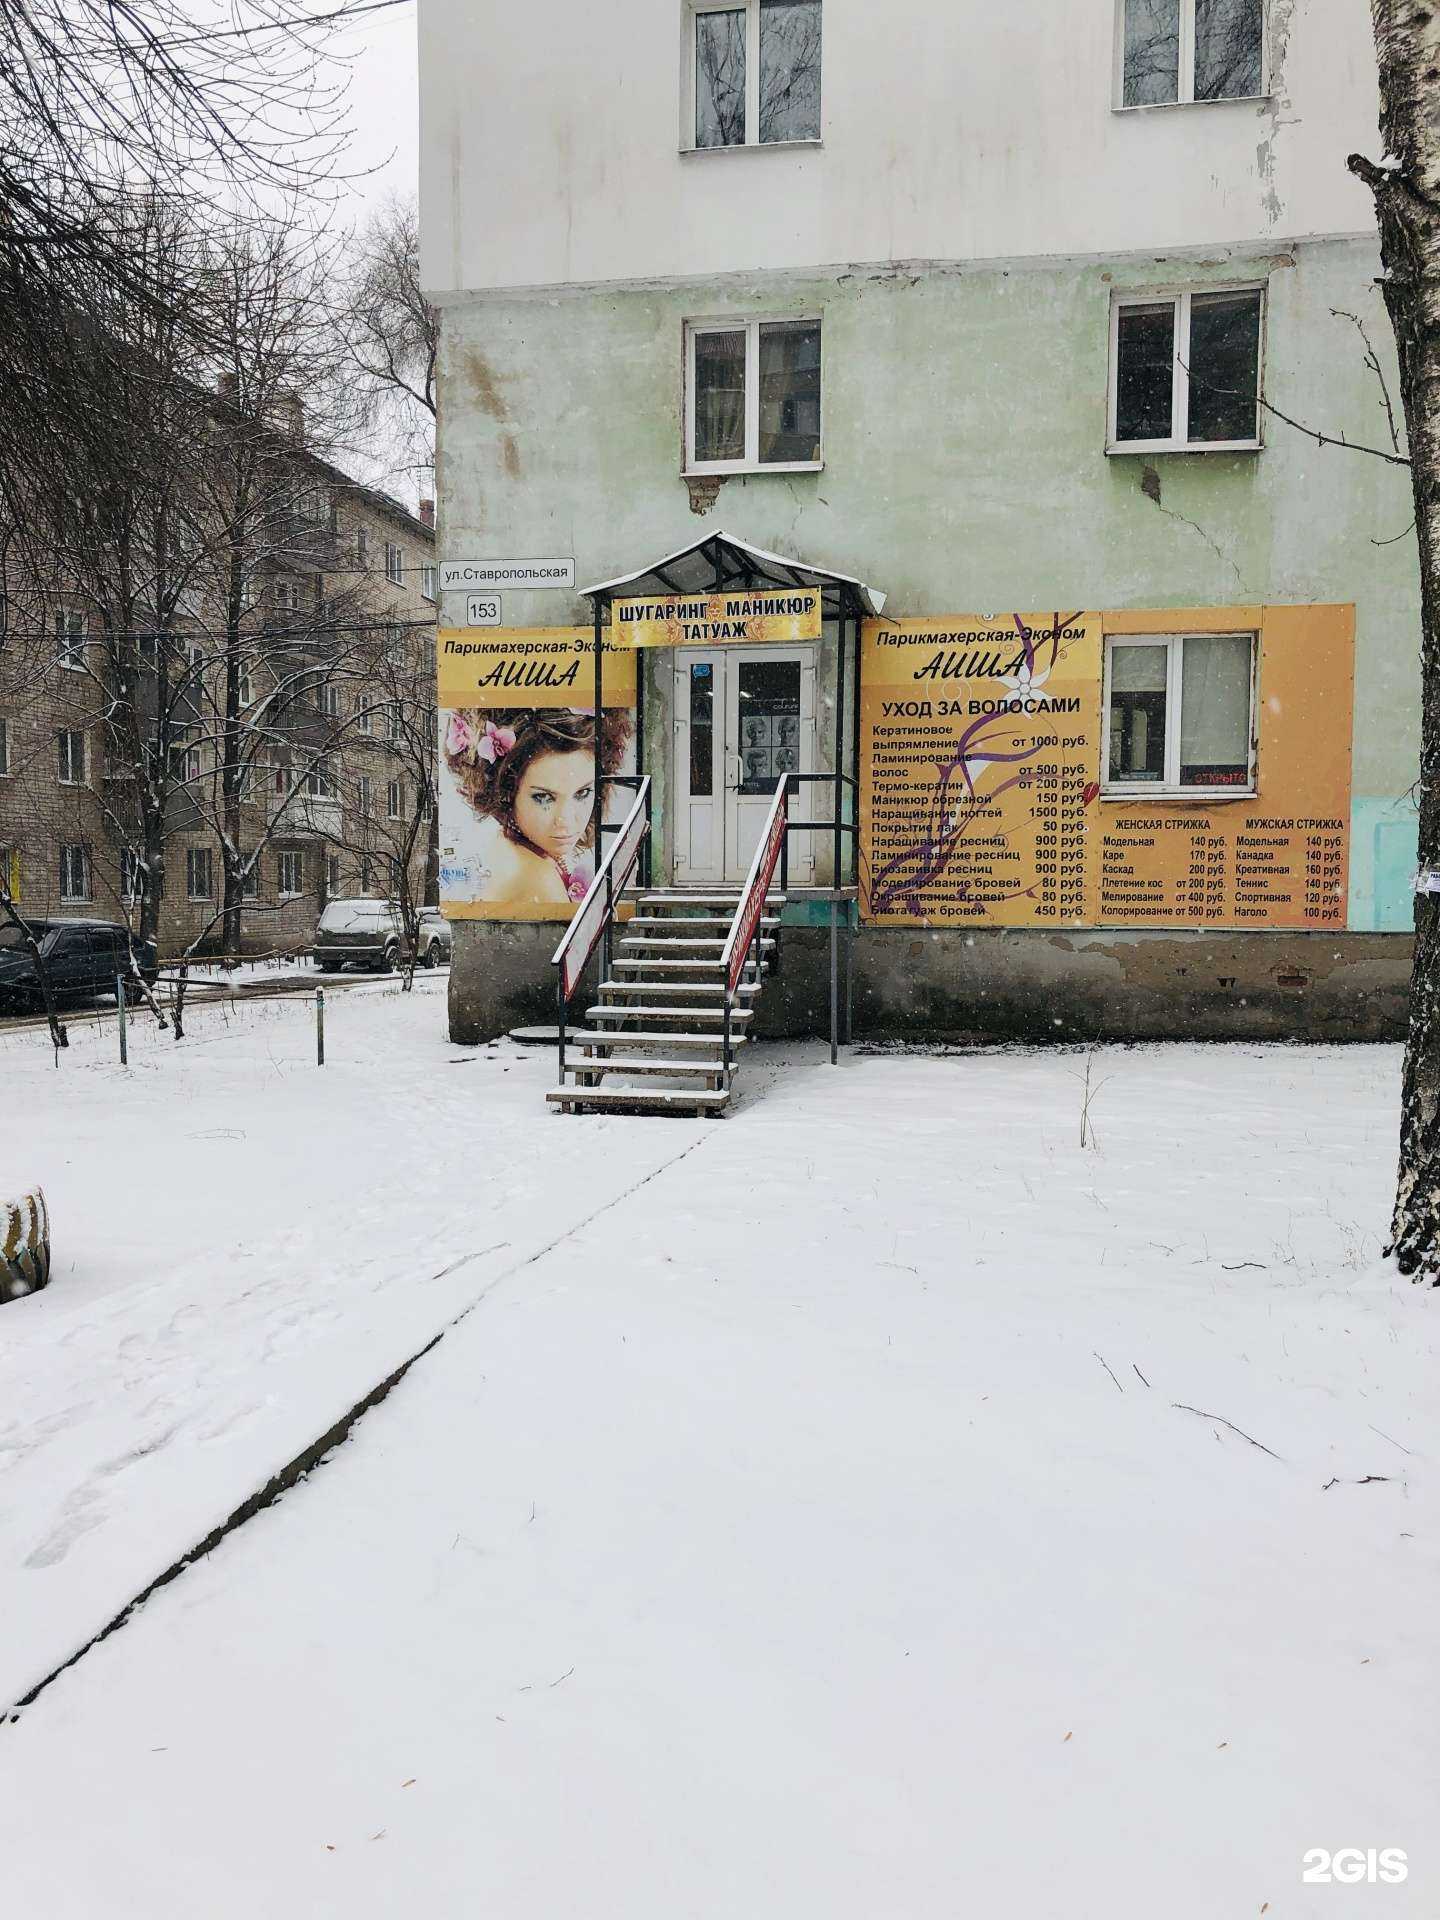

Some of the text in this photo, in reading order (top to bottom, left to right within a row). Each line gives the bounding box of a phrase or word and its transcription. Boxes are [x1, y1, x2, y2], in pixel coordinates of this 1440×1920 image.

[445, 567, 568, 582] ул.Ставропольская
[470, 602, 497, 618] 153
[619, 597, 815, 622] ШУГАРИНГ МАНИКЮР
[682, 621, 748, 640] ТАТУАЖ
[877, 627, 1085, 647] Парикмахерская-Эконом
[914, 649, 1027, 679] АИША
[479, 660, 580, 687] АИША
[882, 698, 1080, 718] УХОД ЗА ВОЛОСАМИ
[873, 726, 952, 736] Кератиновое
[873, 736, 1089, 749] выпрямление от 1000 руб.
[872, 753, 972, 764] Ламинирование
[873, 765, 1088, 777] волос от 500 руб.
[873, 781, 963, 791] Термо-кератин
[1019, 781, 1033, 789] от
[1037, 779, 1057, 789] 200
[872, 796, 928, 806] Маникюр
[932, 795, 991, 806] обрезной
[1037, 793, 1057, 803] 150
[872, 808, 1088, 820] Наращивание ногтей 1500 руб.
[872, 822, 1088, 834] Покрытие лак 50 руб.
[1116, 820, 1210, 829] ЖЕНСКАЯ СТРИЖКА
[1246, 820, 1343, 829] МУЖСКАЯ СТРИЖКА
[872, 836, 1088, 848] Наращивание ресниц 900 руб.
[1104, 836, 1228, 849] Модельная 140 руб.
[1236, 836, 1344, 849] Модельная 140 руб.
[872, 850, 1087, 862] Ламинирование ресниц 900 руб.
[1103, 851, 1124, 861] Каре
[1208, 851, 1227, 862] руб.
[1236, 850, 1343, 862] Канадка 140 руб.
[871, 864, 1087, 875] Биозавивка ресниц 900 руб.
[1103, 865, 1227, 876] Каскад 200 руб.
[1236, 865, 1290, 876] Креативная
[1323, 865, 1343, 876] руб.
[871, 877, 1087, 890] Моделирование бровей 80 руб.
[1102, 878, 1145, 888] Плетение
[1189, 879, 1204, 888] 200
[1207, 878, 1226, 890] руб.
[1236, 879, 1268, 888] Теннис
[1305, 879, 1321, 888] 140
[871, 893, 955, 904] Окрашивание
[1042, 892, 1056, 901] 80
[1061, 892, 1086, 903] руб.
[1102, 892, 1163, 903] Мелирование
[1188, 892, 1204, 902] 400
[1206, 892, 1225, 904] руб.
[1235, 892, 1291, 903] Спортивная
[1304, 893, 1320, 903] 120
[871, 905, 1086, 917] Биотатуаж бровей 450 руб.
[1101, 905, 1225, 918] Колорирование от 500 руб.
[1234, 907, 1341, 919] Наголо 100 руб.
